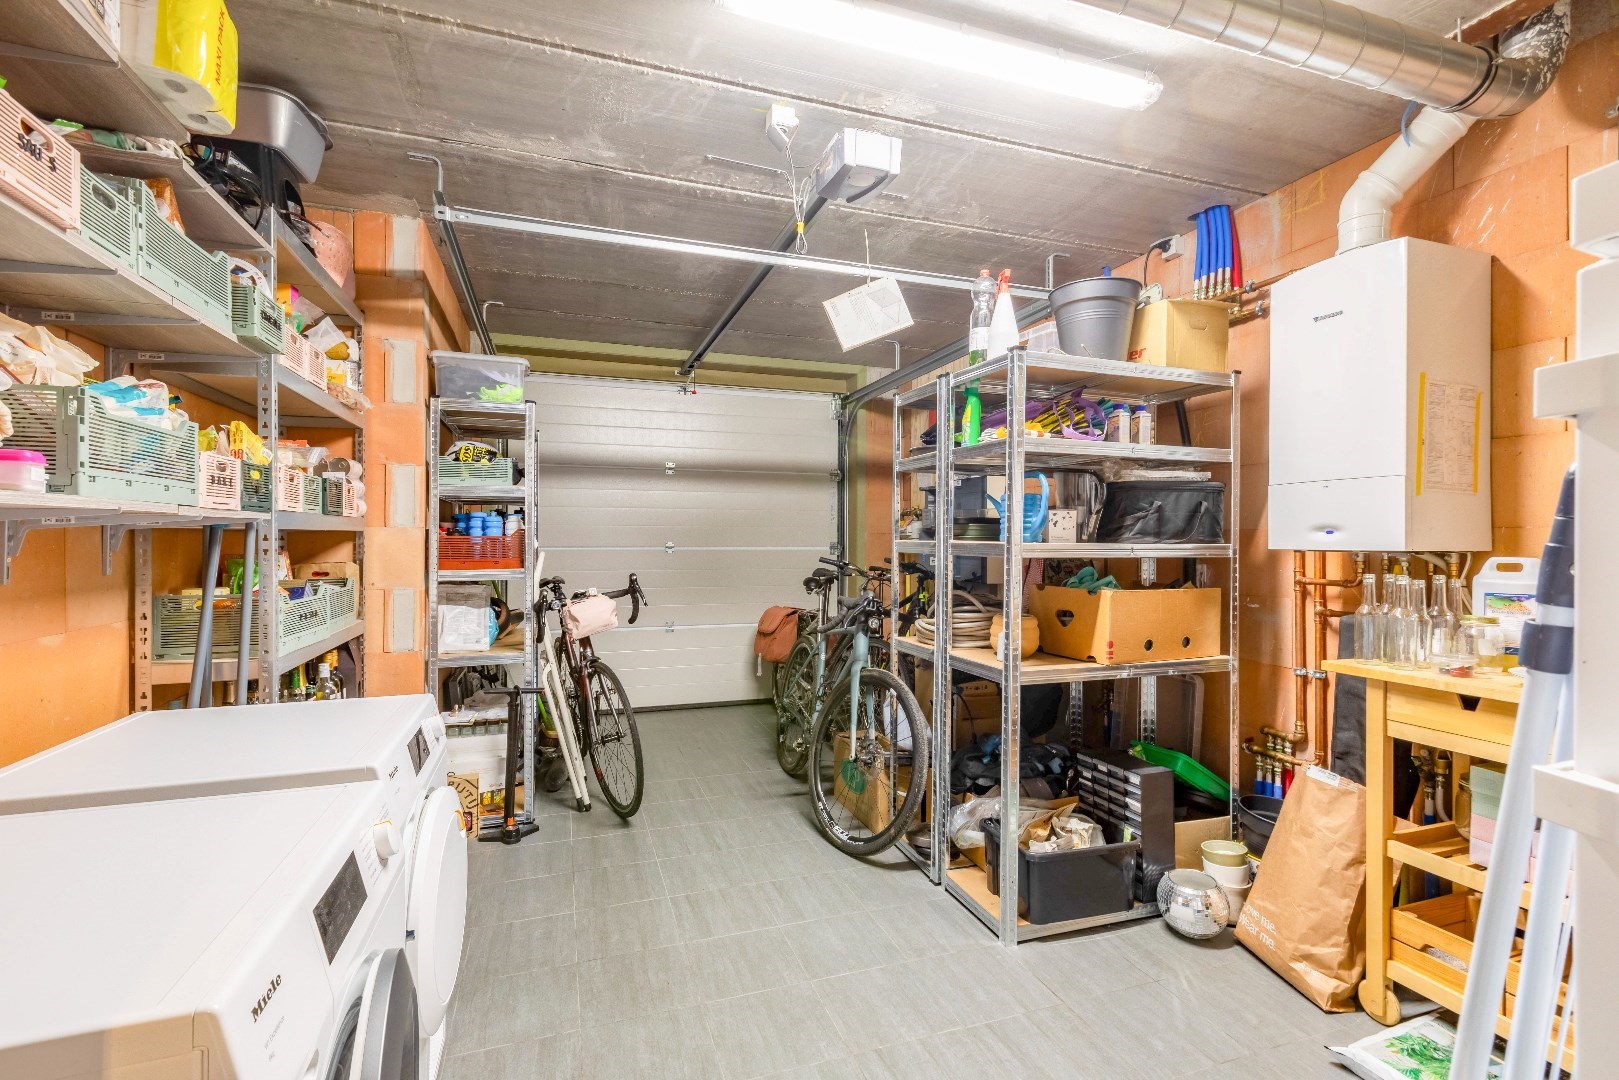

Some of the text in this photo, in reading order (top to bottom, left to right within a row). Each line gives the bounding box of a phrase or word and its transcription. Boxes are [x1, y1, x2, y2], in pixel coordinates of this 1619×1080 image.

[217, 7, 225, 46] PACK
[1128, 347, 1146, 361] er
[1244, 904, 1277, 936] ove me.
[1259, 931, 1277, 952] me.
[251, 973, 282, 1024] Miele
